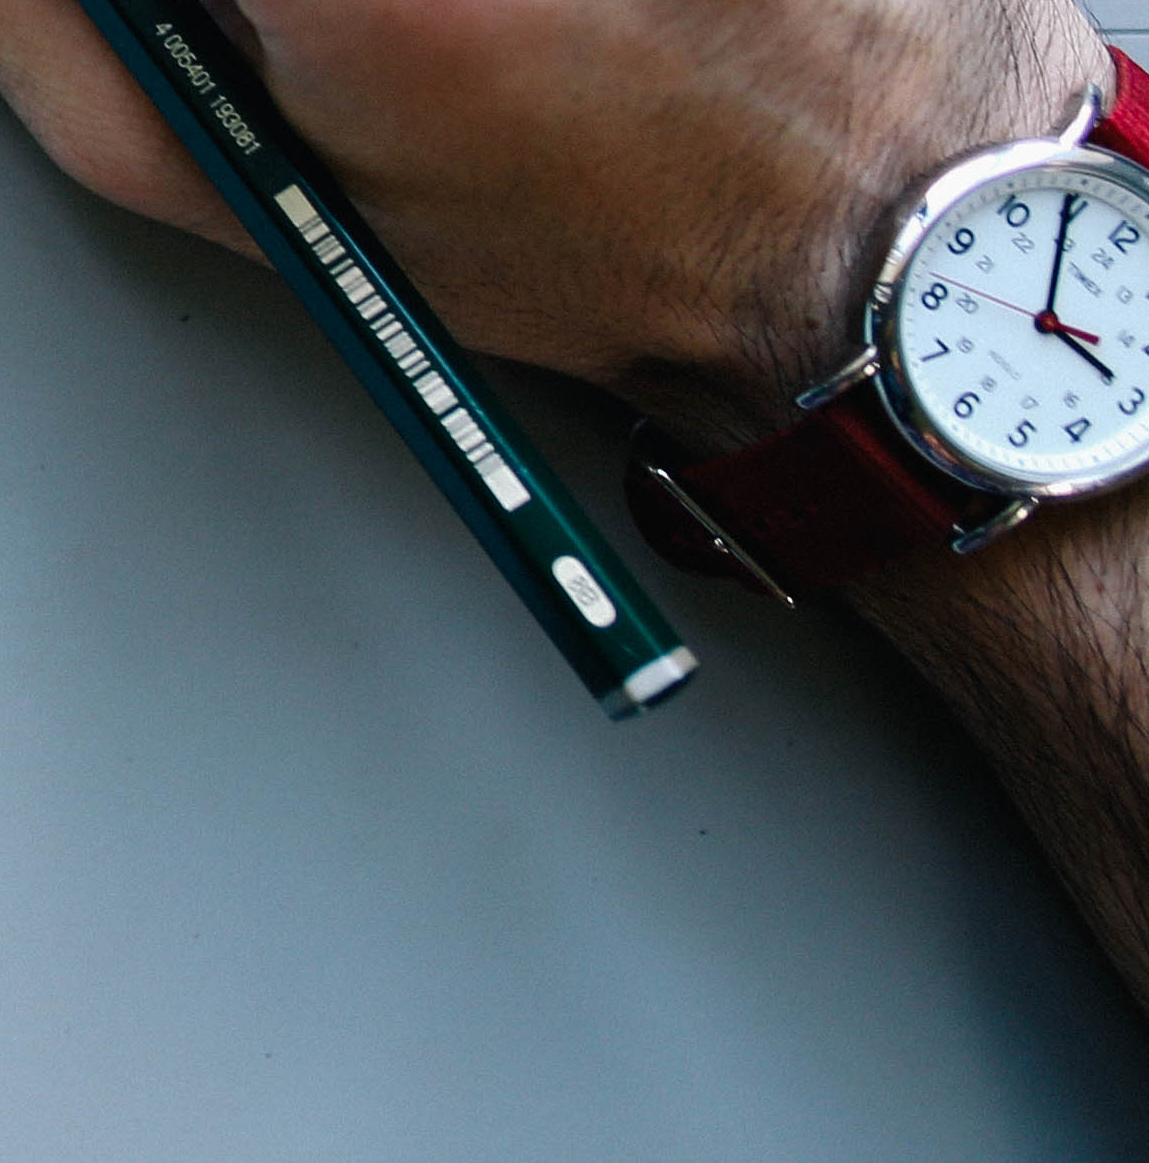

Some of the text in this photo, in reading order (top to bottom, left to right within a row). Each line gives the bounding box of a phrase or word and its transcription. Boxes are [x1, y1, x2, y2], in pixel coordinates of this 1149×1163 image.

[155, 22, 262, 156] 4 005401 193081
[997, 193, 1031, 228] 10
[946, 227, 975, 255] 9
[1011, 231, 1035, 254] 22
[1108, 219, 1141, 255] 12
[921, 282, 948, 311] 8
[919, 337, 950, 363] 7
[953, 390, 982, 419] 6
[1116, 386, 1146, 416] 3
[1007, 419, 1038, 448] 5
[1062, 417, 1092, 443] 4
